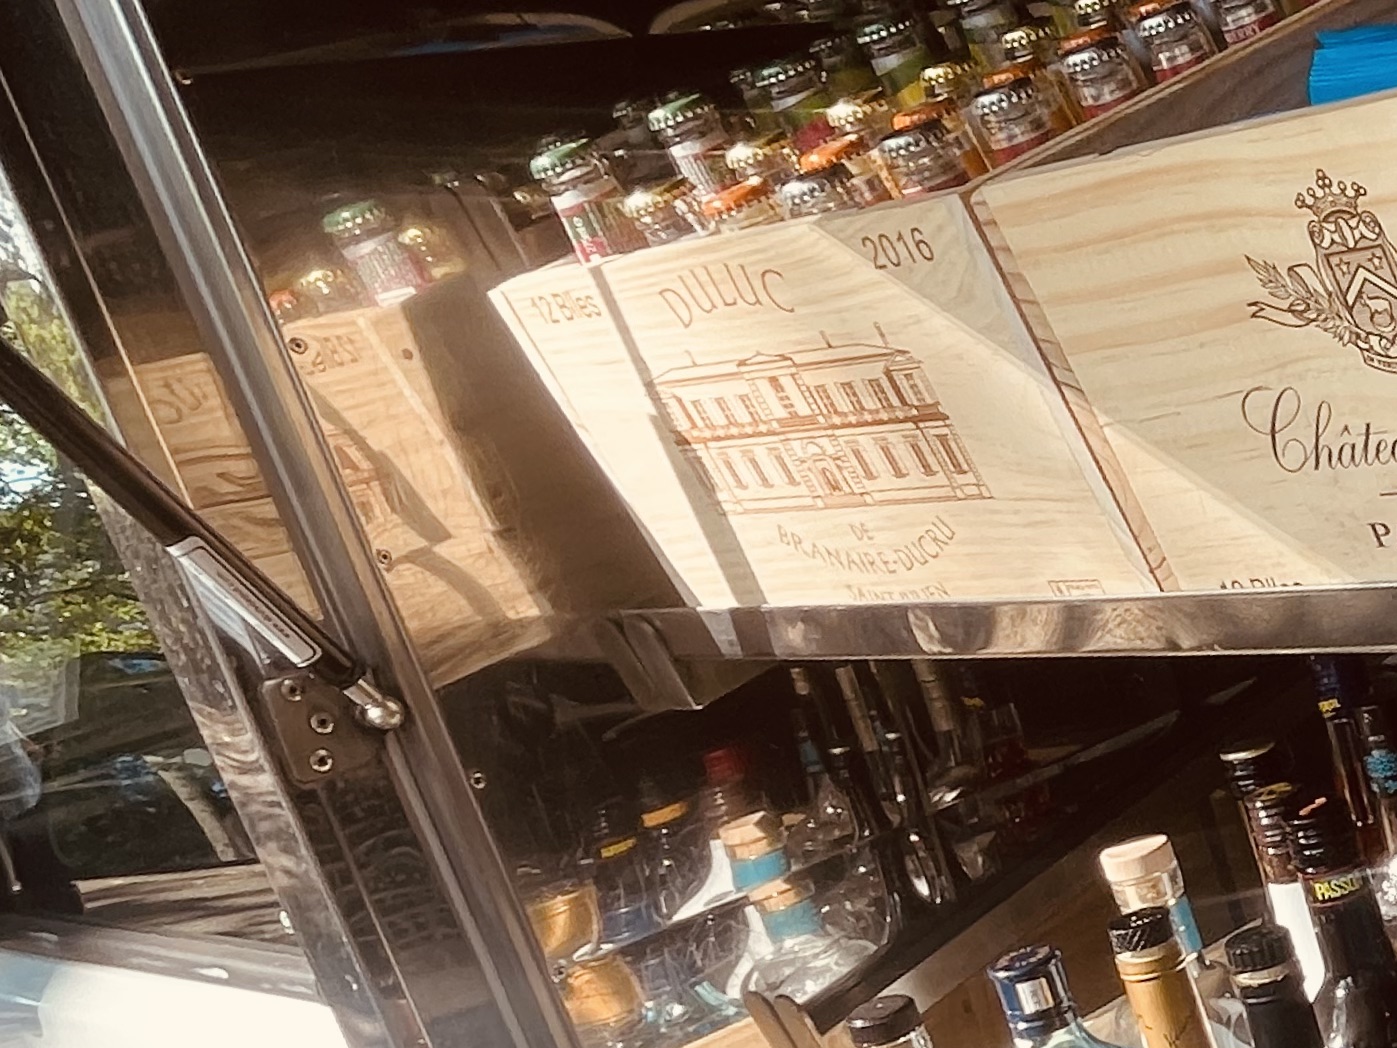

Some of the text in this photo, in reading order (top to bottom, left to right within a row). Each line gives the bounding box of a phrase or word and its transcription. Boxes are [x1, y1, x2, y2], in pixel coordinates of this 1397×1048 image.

[861, 226, 935, 271] 2016
[529, 295, 560, 324] 12
[658, 262, 795, 329] DULUC
[776, 514, 956, 576] BRANAIRE-DUCRU
[847, 522, 875, 541] DE
